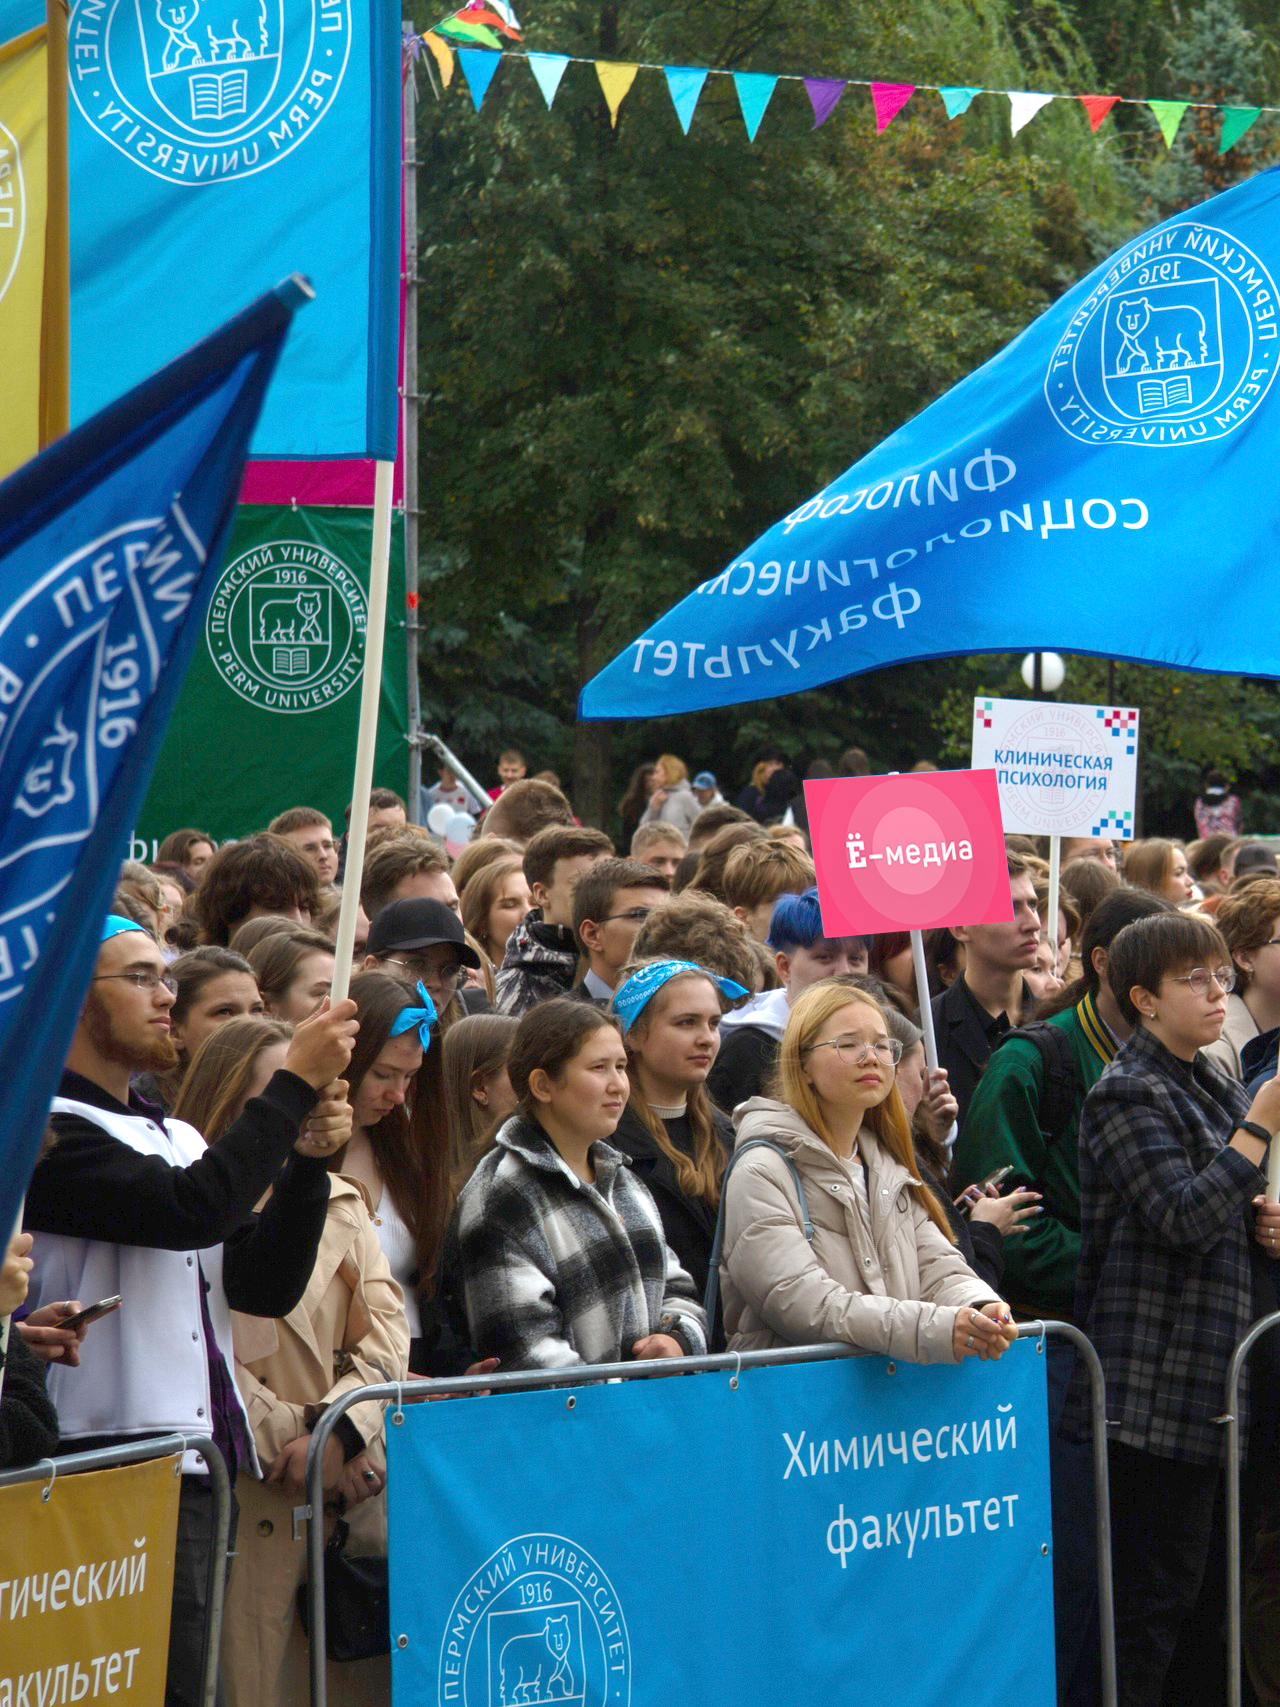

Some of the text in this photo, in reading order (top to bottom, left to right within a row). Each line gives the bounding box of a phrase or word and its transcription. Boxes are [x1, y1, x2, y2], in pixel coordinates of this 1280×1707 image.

[212, 546, 367, 635] ПЕРМСКИЙ УНИВЕРСИТЕТ
[274, 569, 308, 584] 1916
[98, 633, 141, 748] 1916
[218, 652, 363, 708] PERM UNIVERSITY
[1044, 726, 1066, 738] 1916
[994, 750, 1113, 771] КЛИНИЧЕСКАЯ
[998, 770, 1107, 790] ПСИХОЛОГИЯ
[1005, 786, 1100, 829] PERM UNIVERSITY
[845, 832, 973, 869] Ё-медиа
[782, 1403, 1017, 1480] Химический
[826, 1494, 1019, 1569] факультет
[519, 1581, 553, 1605] 1916
[444, 1543, 626, 1700] ПЕРМСКИЙ УНИВЕРСИТЕТ
